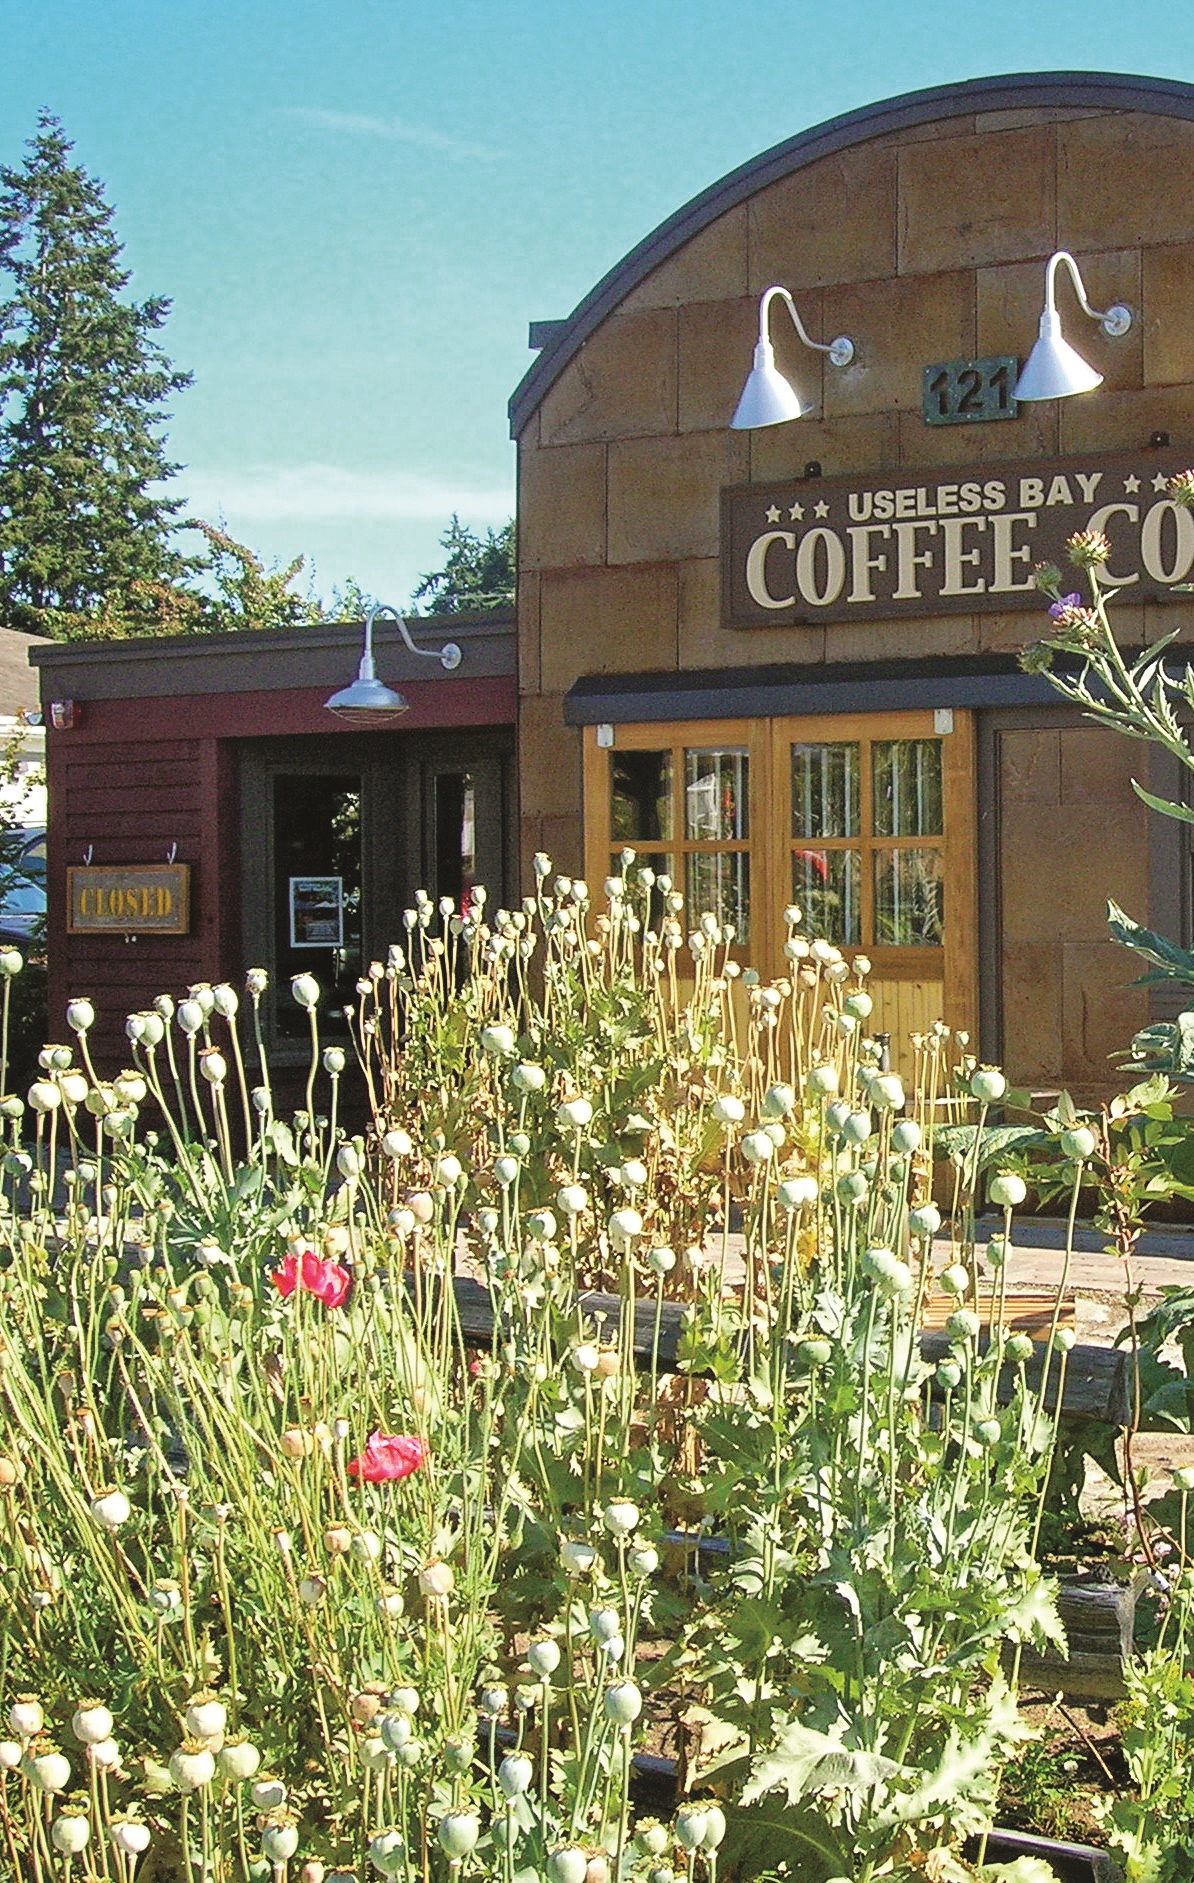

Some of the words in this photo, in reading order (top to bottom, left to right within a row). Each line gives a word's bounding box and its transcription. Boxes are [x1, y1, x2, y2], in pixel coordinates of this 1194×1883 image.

[929, 365, 1009, 415] 121
[848, 482, 1004, 521] USELESS
[1020, 472, 1103, 508] BAY
[745, 511, 1038, 610] COFFEE
[79, 886, 173, 917] CLOSED
